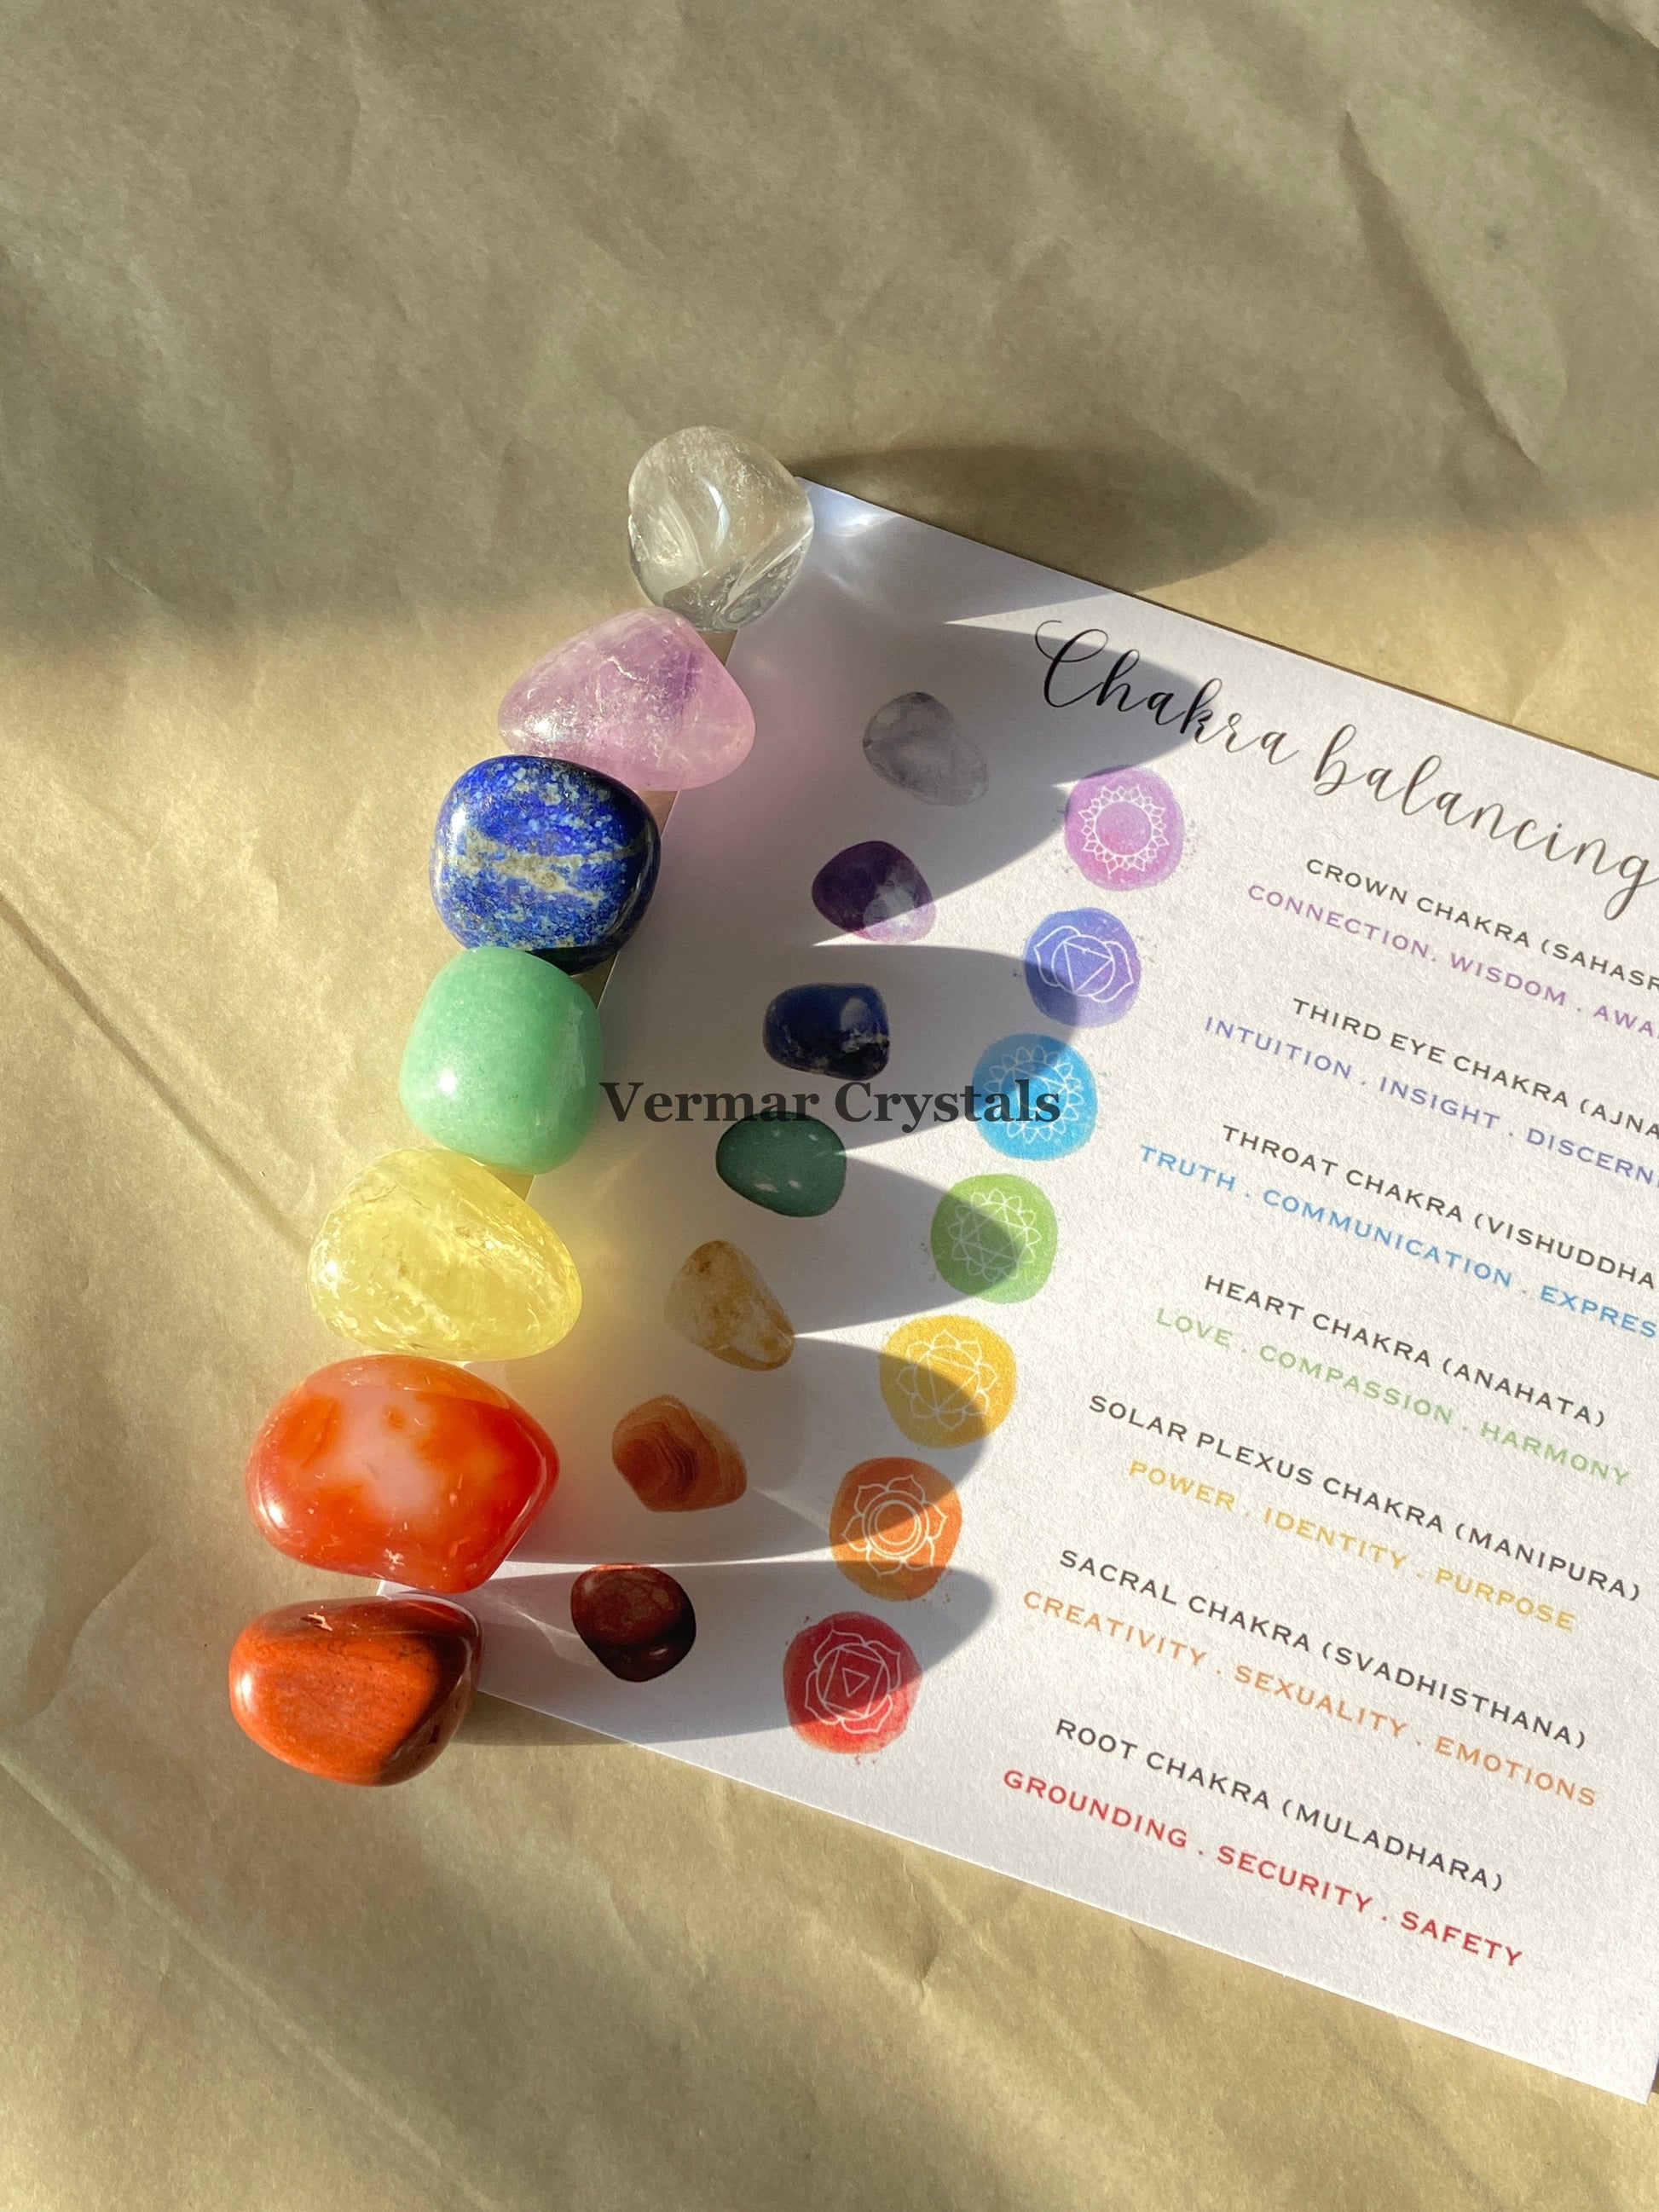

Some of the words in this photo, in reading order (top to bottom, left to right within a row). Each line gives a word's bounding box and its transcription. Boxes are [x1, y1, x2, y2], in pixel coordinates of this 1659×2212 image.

[1034, 620, 1300, 765] Chakra
[1313, 724, 1659, 921] balancing
[1306, 858, 1408, 905] CROWN
[1416, 896, 1530, 949] CHAKRA
[1292, 997, 1382, 1042] THIRD
[1390, 1031, 1447, 1066] EYE
[1454, 1054, 1569, 1108] CHAKRA
[1580, 1098, 1659, 1141] (AJNA
[1450, 953, 1567, 1007] WISDOM
[1593, 1005, 1659, 1039] AWA
[1205, 1017, 1352, 1080] INTUITION
[1379, 1076, 1501, 1129] INSIGHT
[1526, 1127, 1659, 1188] DISCERN
[1140, 1144, 1236, 1192] TRUTH
[1263, 1188, 1512, 1288] COMMUNICATION
[1540, 1285, 1657, 1338] EXPRES
[1223, 1123, 1339, 1177] THROAT
[1345, 1169, 1463, 1223] CHAKRA
[1474, 1213, 1655, 1291] (VISHUDDHA
[1156, 1308, 1233, 1348] LOVE
[1259, 1344, 1453, 1424] COMPASSION
[1481, 1422, 1629, 1486] HARMONY
[1205, 1273, 1305, 1321] HEART
[1313, 1313, 1431, 1368] CHAKRA
[1442, 1357, 1605, 1428] (ANAHATA)
[1090, 1395, 1188, 1443] SOLAR
[1195, 1432, 1315, 1487] PLEXUS
[1323, 1476, 1443, 1533] CHAKRA
[1454, 1522, 1640, 1603] (MANIPURA)
[1129, 1459, 1235, 1511] POWER
[1263, 1507, 1407, 1569] IDENTITY
[1435, 1568, 1575, 1632] PURPOSE
[1023, 1591, 1207, 1666] CREATIVITY
[1234, 1665, 1408, 1738] SEXUALITY
[1435, 1736, 1596, 1806] EMOTIONS
[1060, 1549, 1177, 1606] SACRAL
[1188, 1594, 1310, 1653] CHAKRA
[1321, 1641, 1586, 1750] (SVADHISTHANA)
[1003, 1769, 1188, 1849] GROUNDING
[1217, 1844, 1373, 1914] SECURITY
[1400, 1909, 1523, 1967] SAFETY
[1055, 1718, 1139, 1760] ROOT
[1146, 1751, 1270, 1811] CHAKRA
[1281, 1799, 1503, 1892] (MULADHARA)
